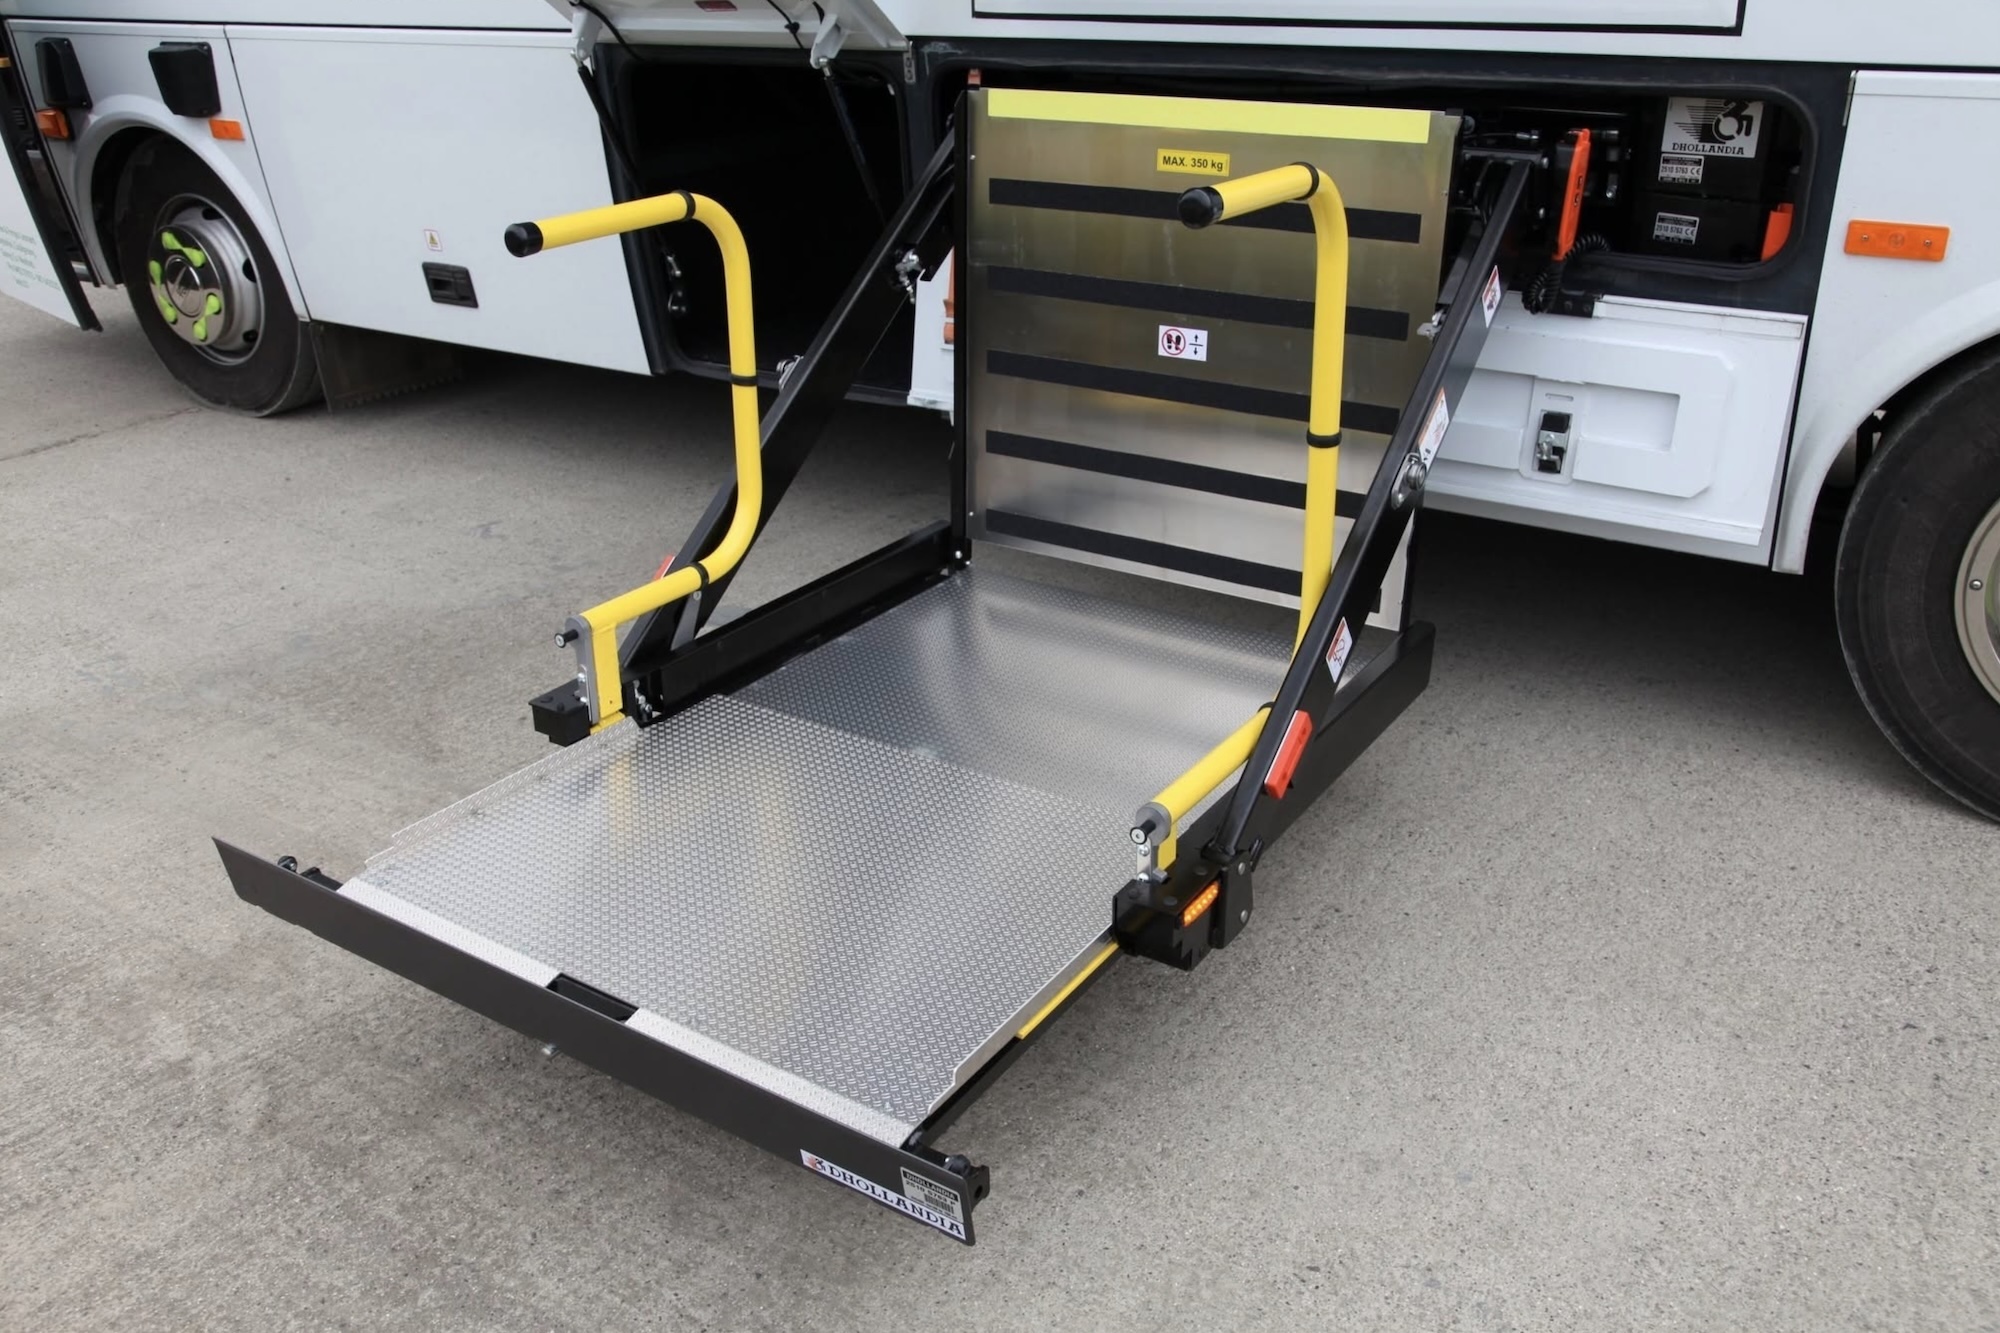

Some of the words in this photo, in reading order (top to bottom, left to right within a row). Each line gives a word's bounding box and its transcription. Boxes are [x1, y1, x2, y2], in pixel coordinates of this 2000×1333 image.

[1672, 142, 1745, 155] DHOLLANDIA
[1162, 155, 1188, 167] MAX.
[1191, 158, 1208, 168] 350
[1211, 159, 1223, 172] kg
[906, 1173, 955, 1200] DHOLLANDIA
[829, 1164, 963, 1236] DHOLLANDIA
